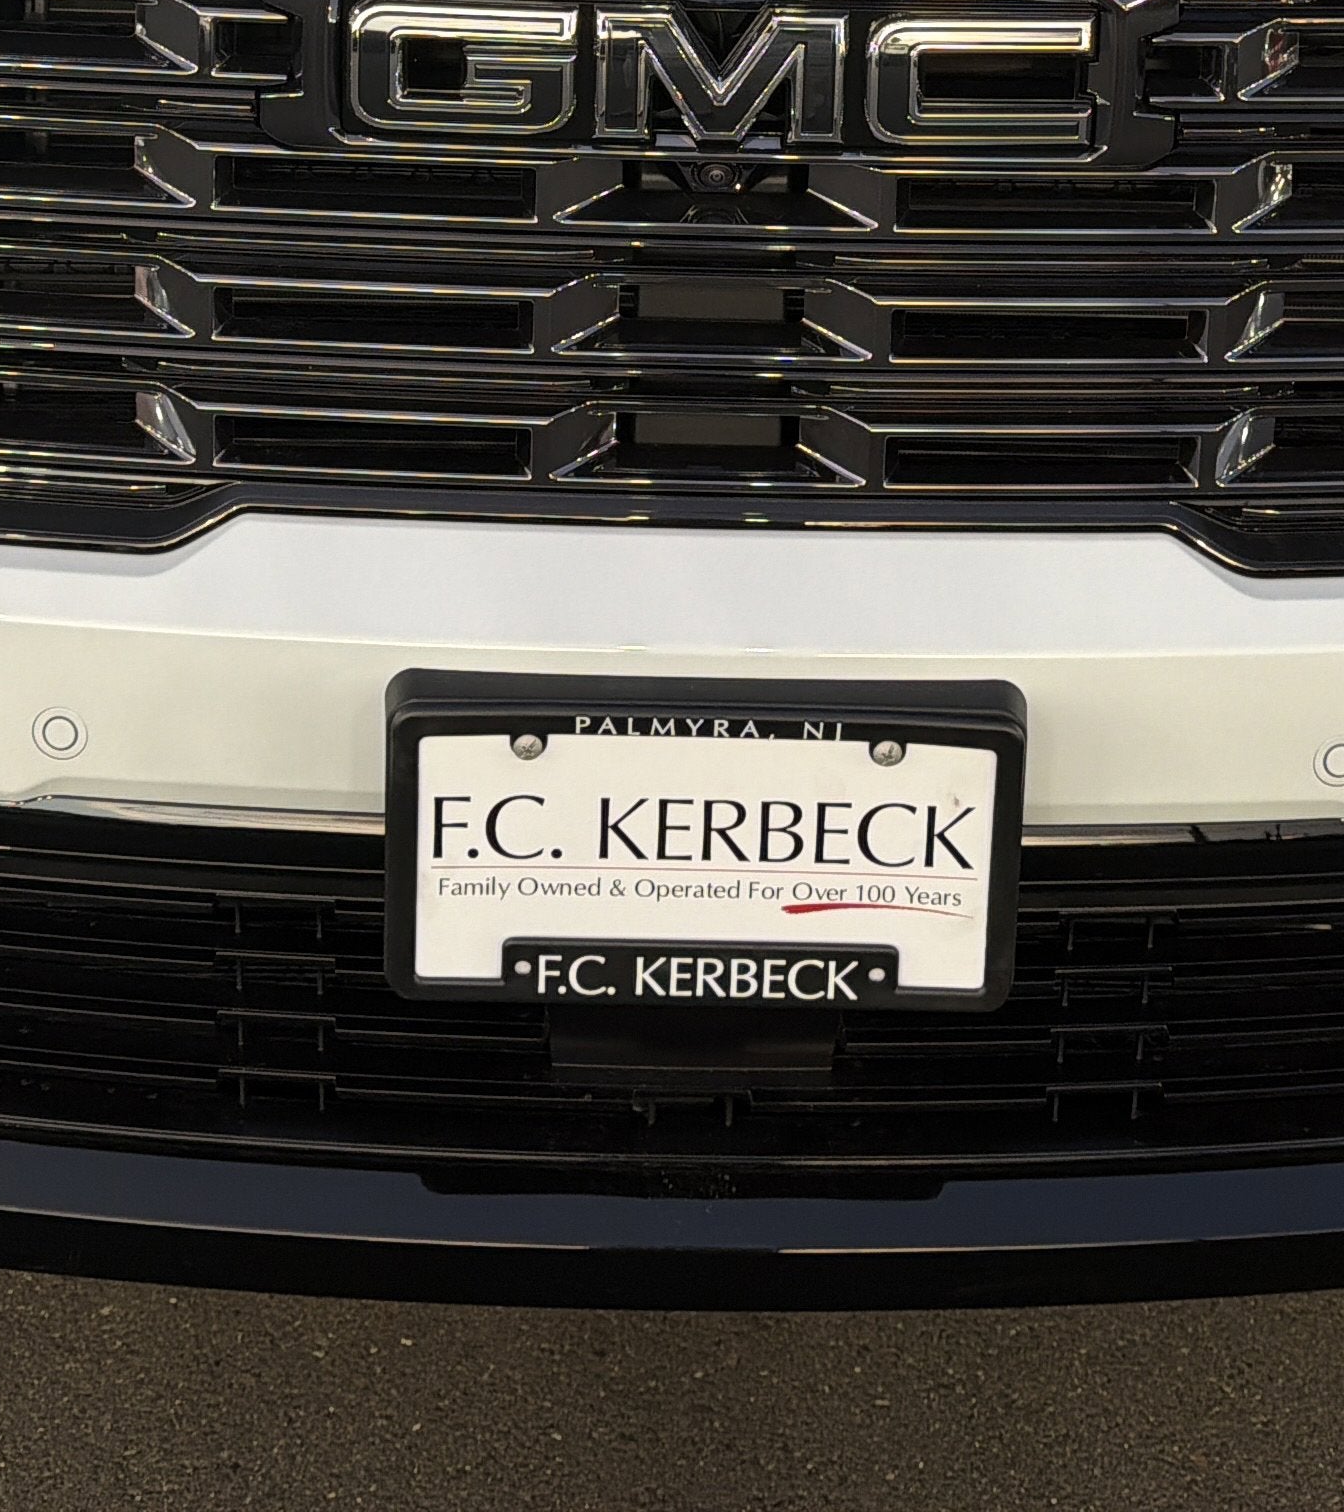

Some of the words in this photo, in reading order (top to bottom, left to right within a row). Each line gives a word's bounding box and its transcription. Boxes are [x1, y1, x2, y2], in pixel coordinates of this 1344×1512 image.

[574, 715, 776, 743] PALMYRA,
[432, 794, 563, 860] F.C.
[598, 797, 977, 870] KERBECK
[438, 876, 511, 900] Family
[517, 876, 602, 897] Owned
[608, 878, 627, 897] &
[634, 878, 741, 902] Operated
[748, 881, 785, 901] For
[792, 881, 848, 902] Over
[855, 884, 896, 903] 100
[904, 885, 963, 907] Years
[537, 954, 617, 996] F.C.
[634, 956, 860, 1001] KERBECK
